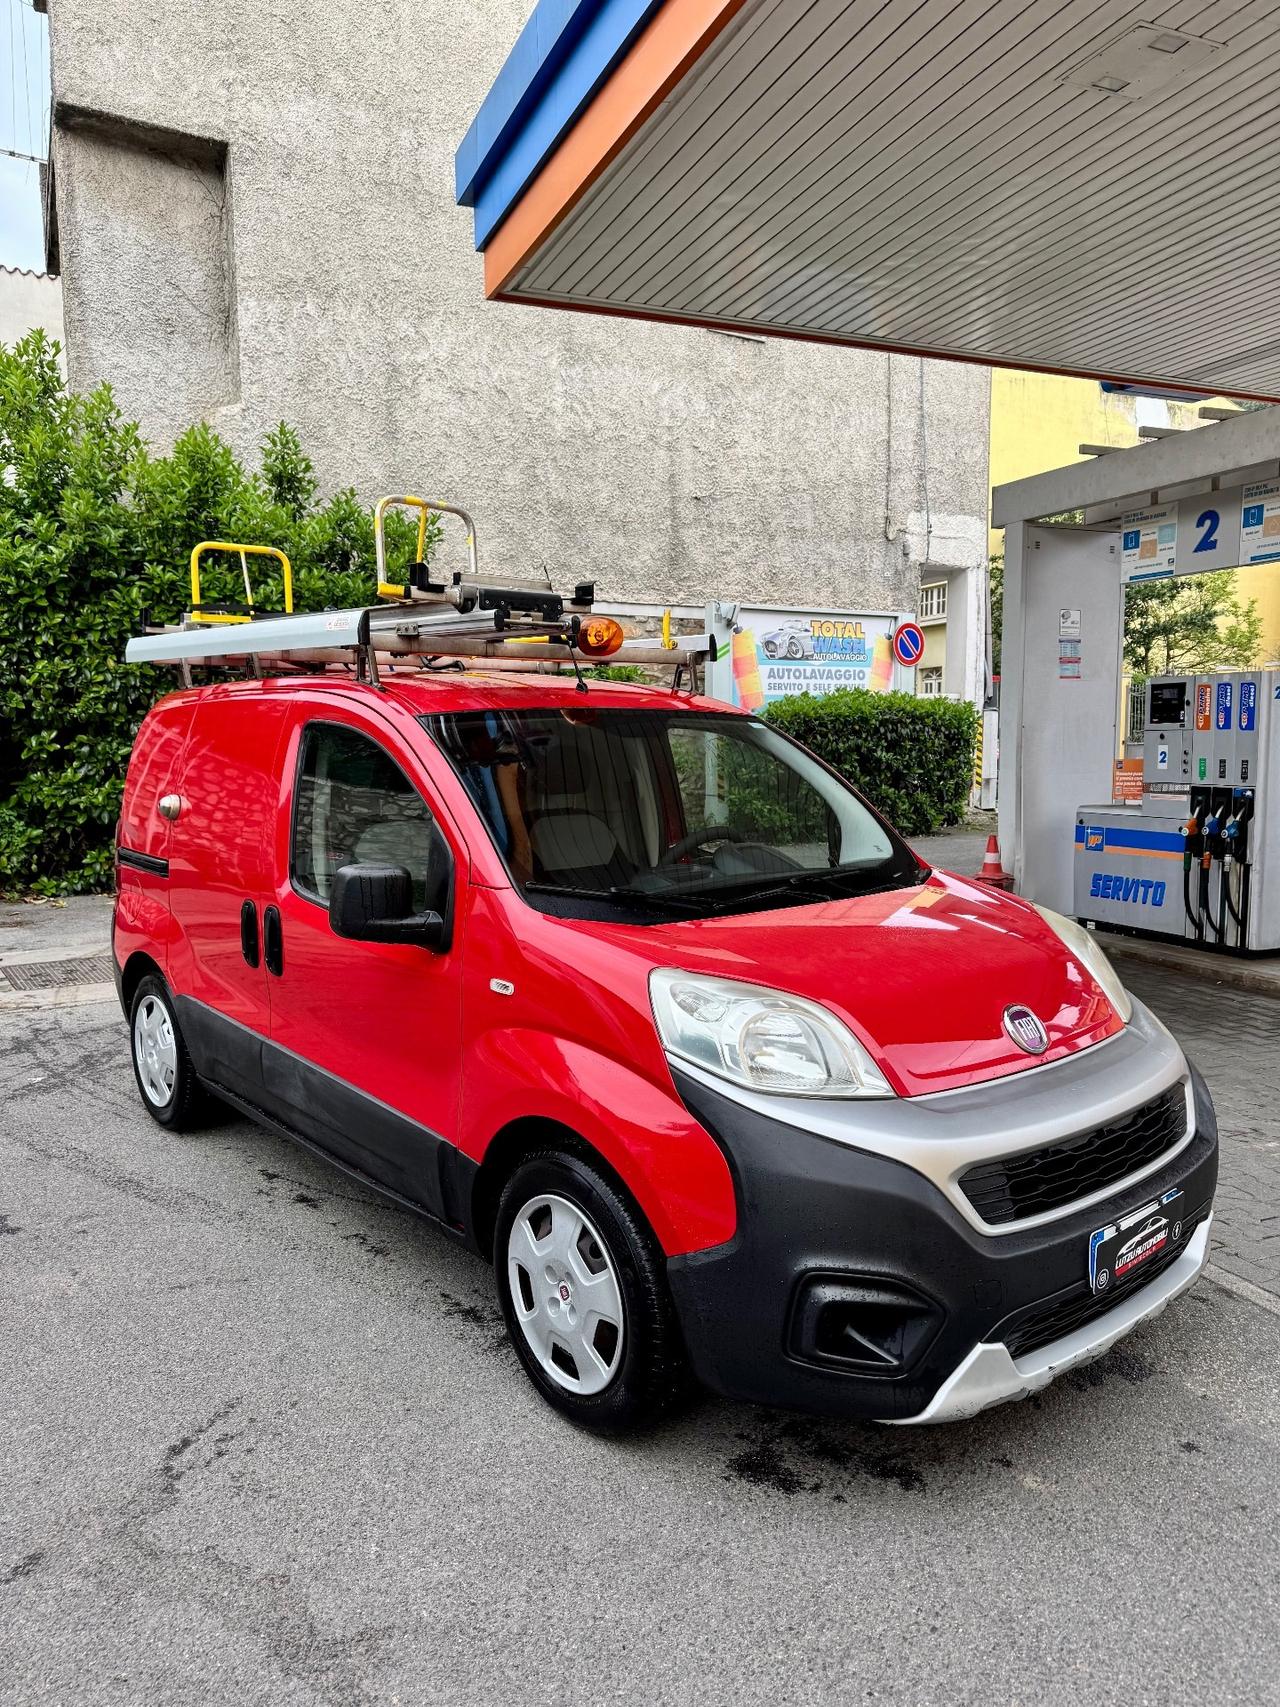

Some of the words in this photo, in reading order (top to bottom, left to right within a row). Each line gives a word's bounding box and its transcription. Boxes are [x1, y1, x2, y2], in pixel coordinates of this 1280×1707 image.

[1193, 510, 1220, 553] 2
[810, 619, 865, 638] TOTAL
[811, 636, 866, 653] WASH
[813, 653, 868, 662] AUTOLAVAGGIO
[767, 667, 866, 681] AUTOLAVAGGIO
[767, 682, 804, 692] SERVITO
[813, 683, 832, 692] SELF
[1159, 751, 1167, 763] 2
[1090, 873, 1166, 907] SERVITO
[1014, 1016, 1041, 1041] FIAT
